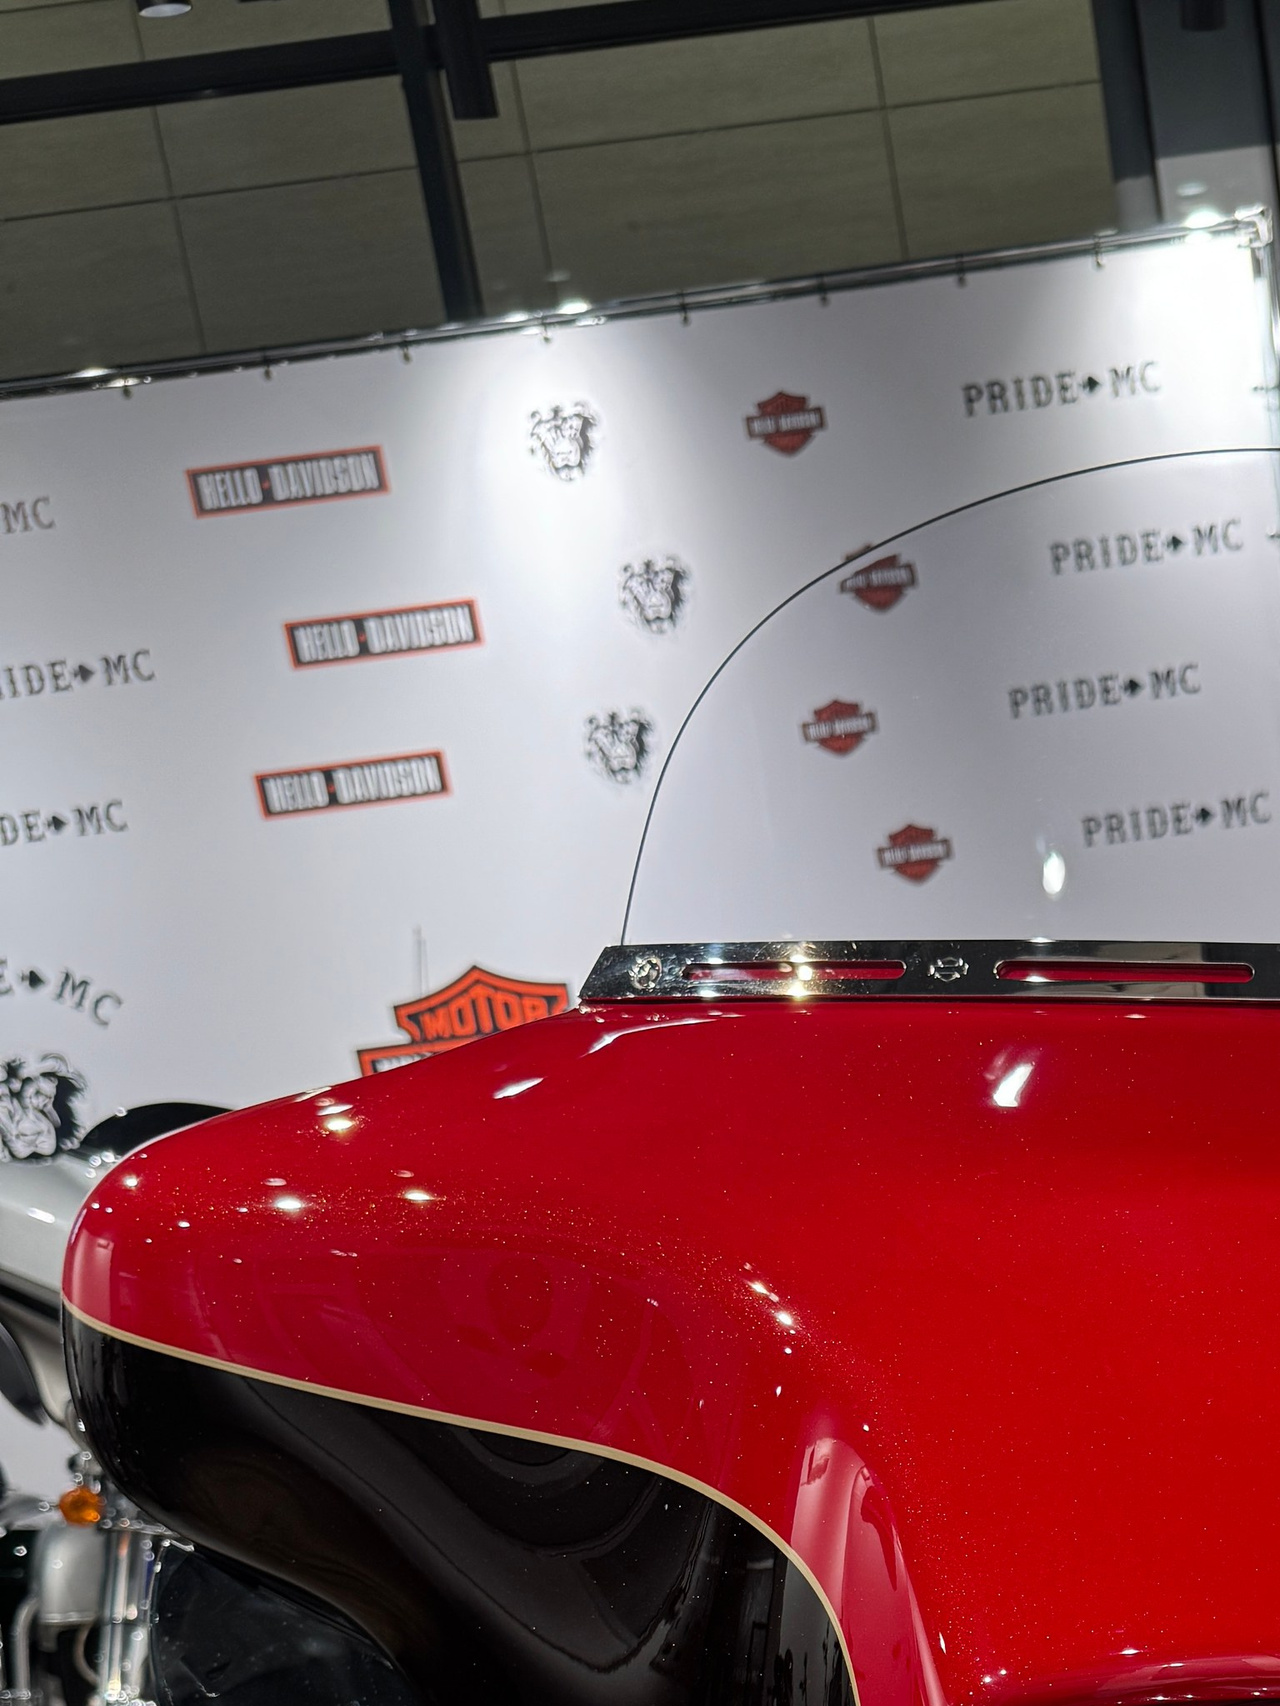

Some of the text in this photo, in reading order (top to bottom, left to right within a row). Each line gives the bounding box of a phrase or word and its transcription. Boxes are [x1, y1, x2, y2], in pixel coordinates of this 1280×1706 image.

[961, 360, 1161, 418] PRIDE MC
[196, 451, 380, 511] HELLO DAVIDSON
[0, 496, 57, 534] MC
[1050, 518, 1244, 576] PRIDE MC
[0, 648, 156, 700] IDE MC
[1008, 663, 1201, 720] PRIDE MC
[72, 799, 129, 838] MC
[1081, 790, 1272, 848] PRIDE MC
[53, 967, 124, 1027] MC
